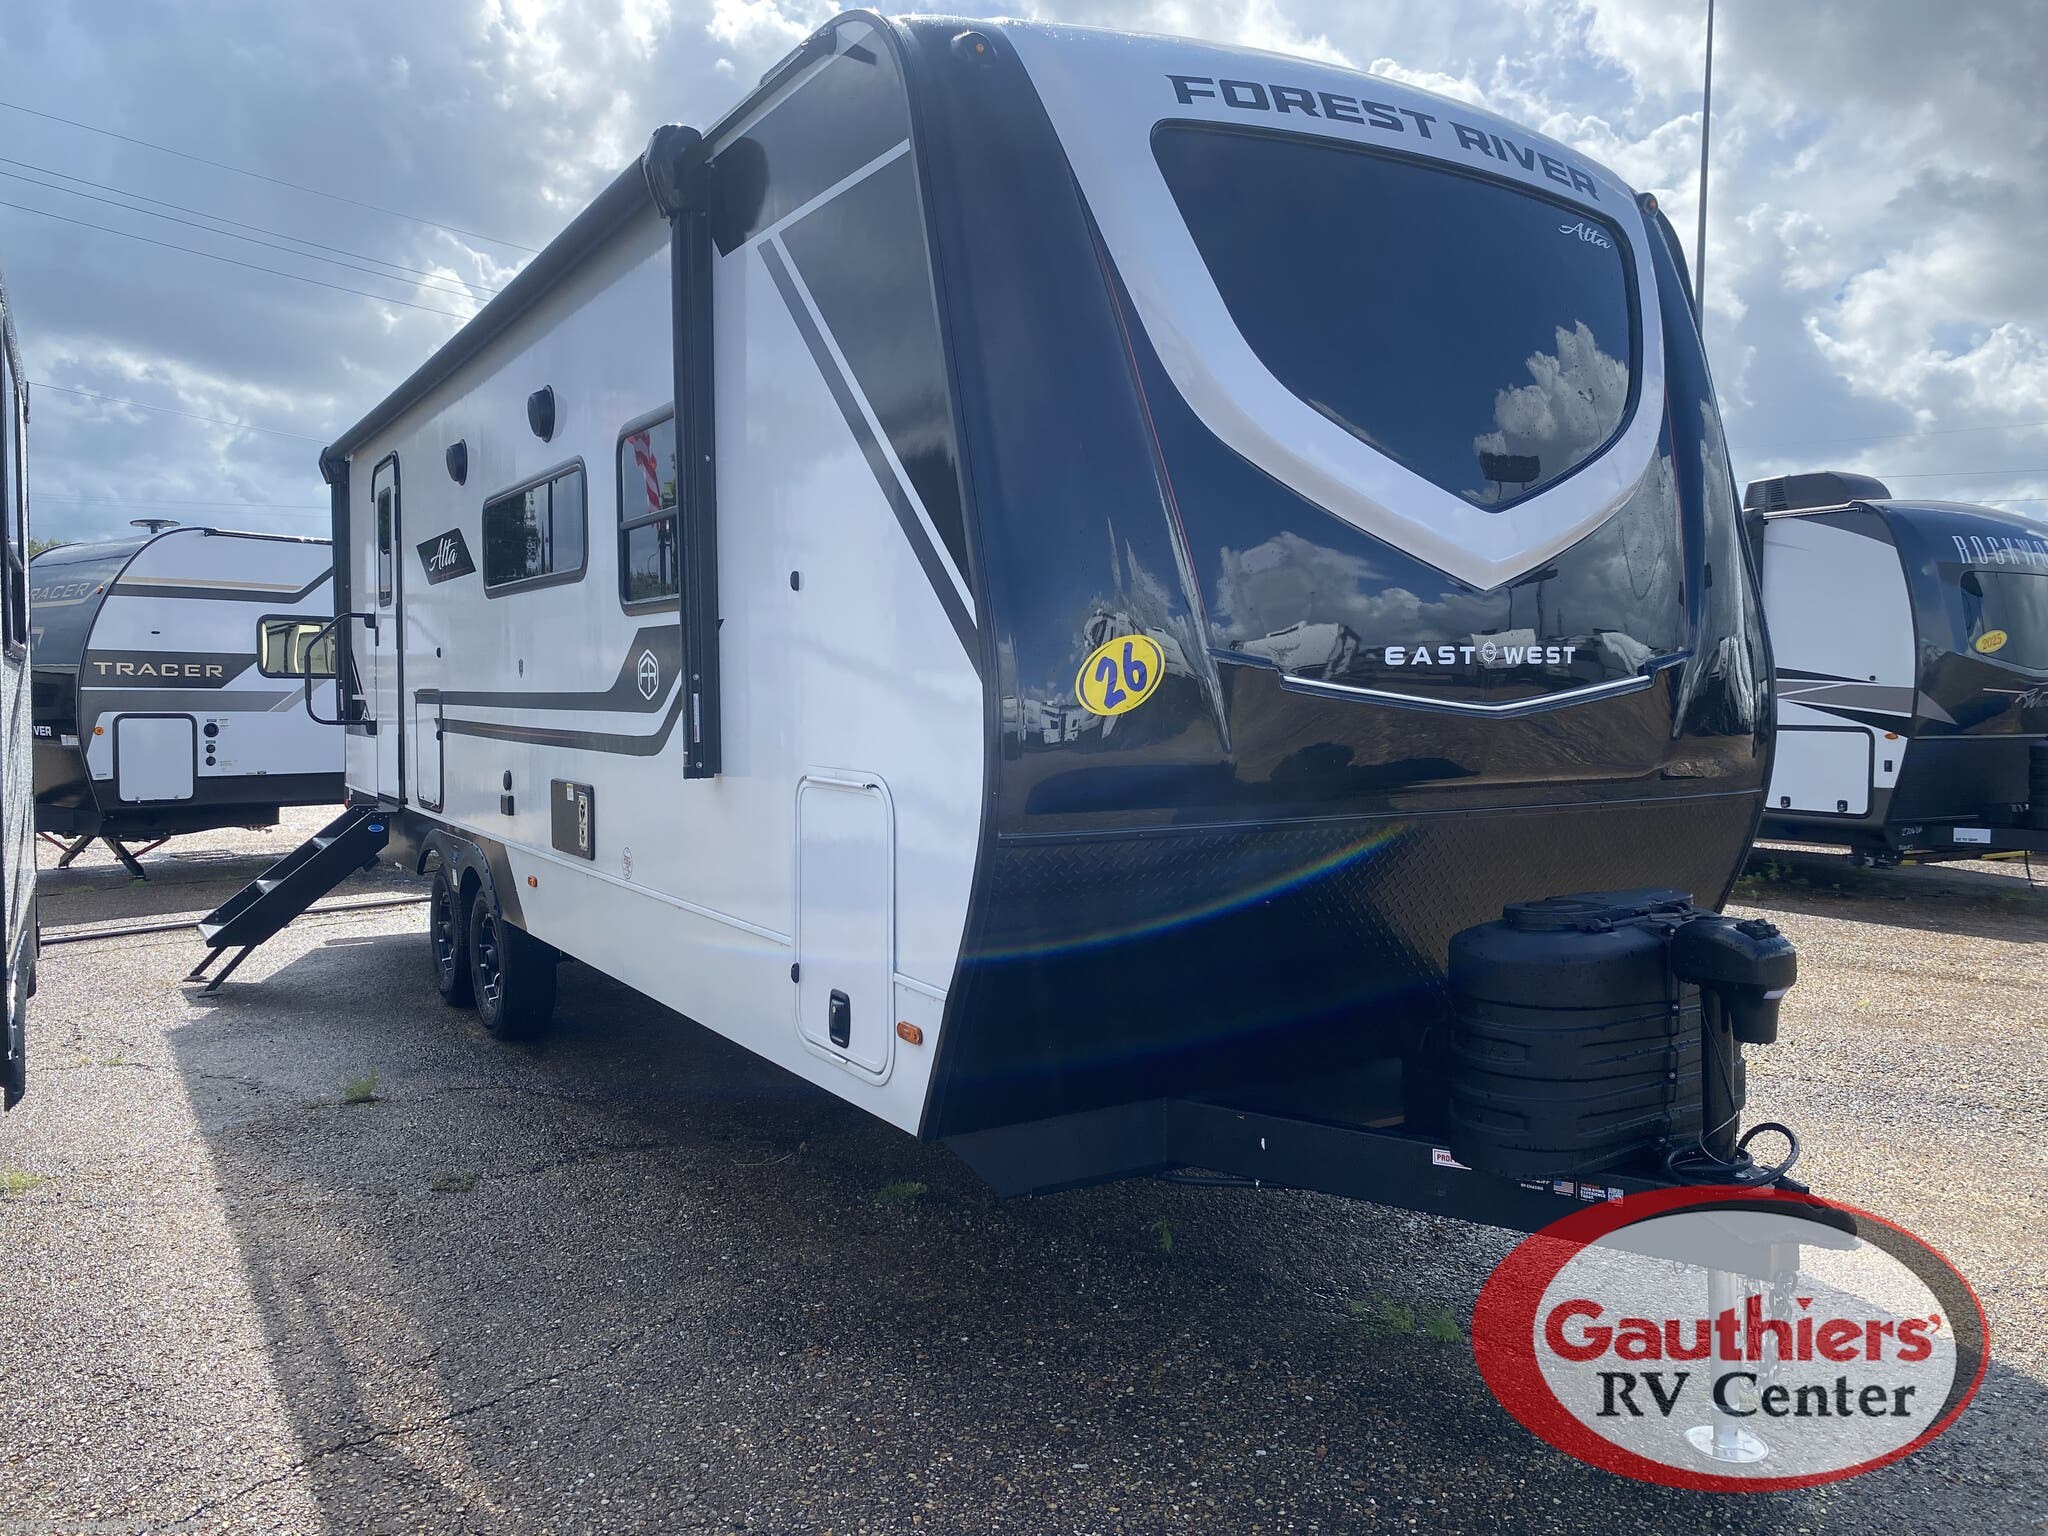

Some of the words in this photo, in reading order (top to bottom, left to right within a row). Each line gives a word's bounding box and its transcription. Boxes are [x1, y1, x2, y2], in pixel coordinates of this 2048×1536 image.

[1165, 74, 1437, 140] FOREST
[1448, 120, 1601, 202] RIVER
[1558, 222, 1613, 249] Alta
[428, 537, 458, 572] Alta
[93, 661, 224, 678] TRACER
[1384, 646, 1476, 666] EAST
[1503, 646, 1576, 665] WEST
[1095, 641, 1148, 710] 26
